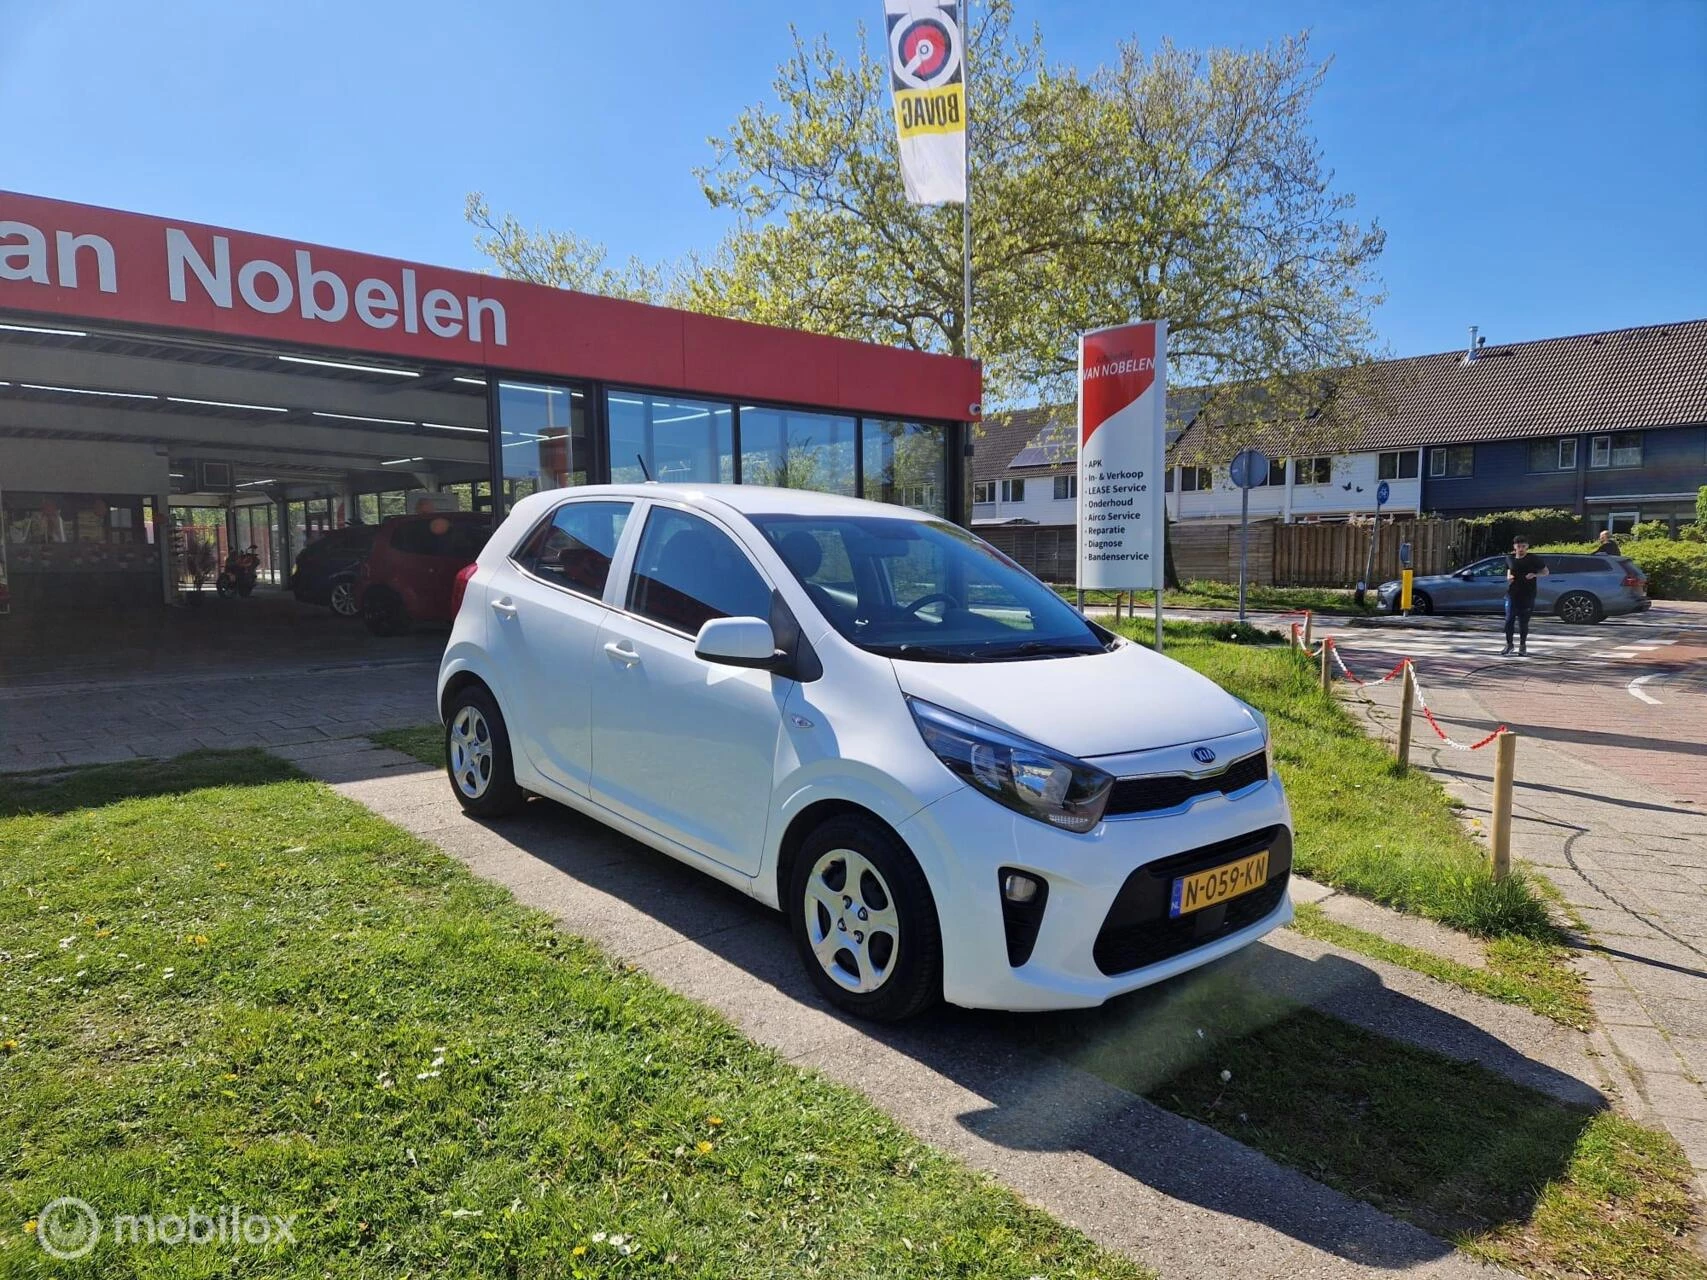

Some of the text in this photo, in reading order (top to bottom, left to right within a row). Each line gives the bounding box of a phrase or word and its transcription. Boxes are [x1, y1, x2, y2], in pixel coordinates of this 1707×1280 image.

[165, 227, 508, 346] Nobelen
[1083, 357, 1155, 380] VAN NOBELEN
[1088, 459, 1103, 469] APK
[1106, 470, 1144, 481] Verkoop
[1088, 484, 1147, 495] LEASE Service
[1088, 498, 1134, 509] Onderhoud
[1088, 511, 1141, 522] Airco Service
[1088, 526, 1126, 536] Reparatie
[1088, 540, 1123, 550] Diagnose
[1088, 552, 1150, 562] Bandenservice
[1195, 749, 1215, 762] KIA
[1185, 856, 1266, 908] N-059-KN
